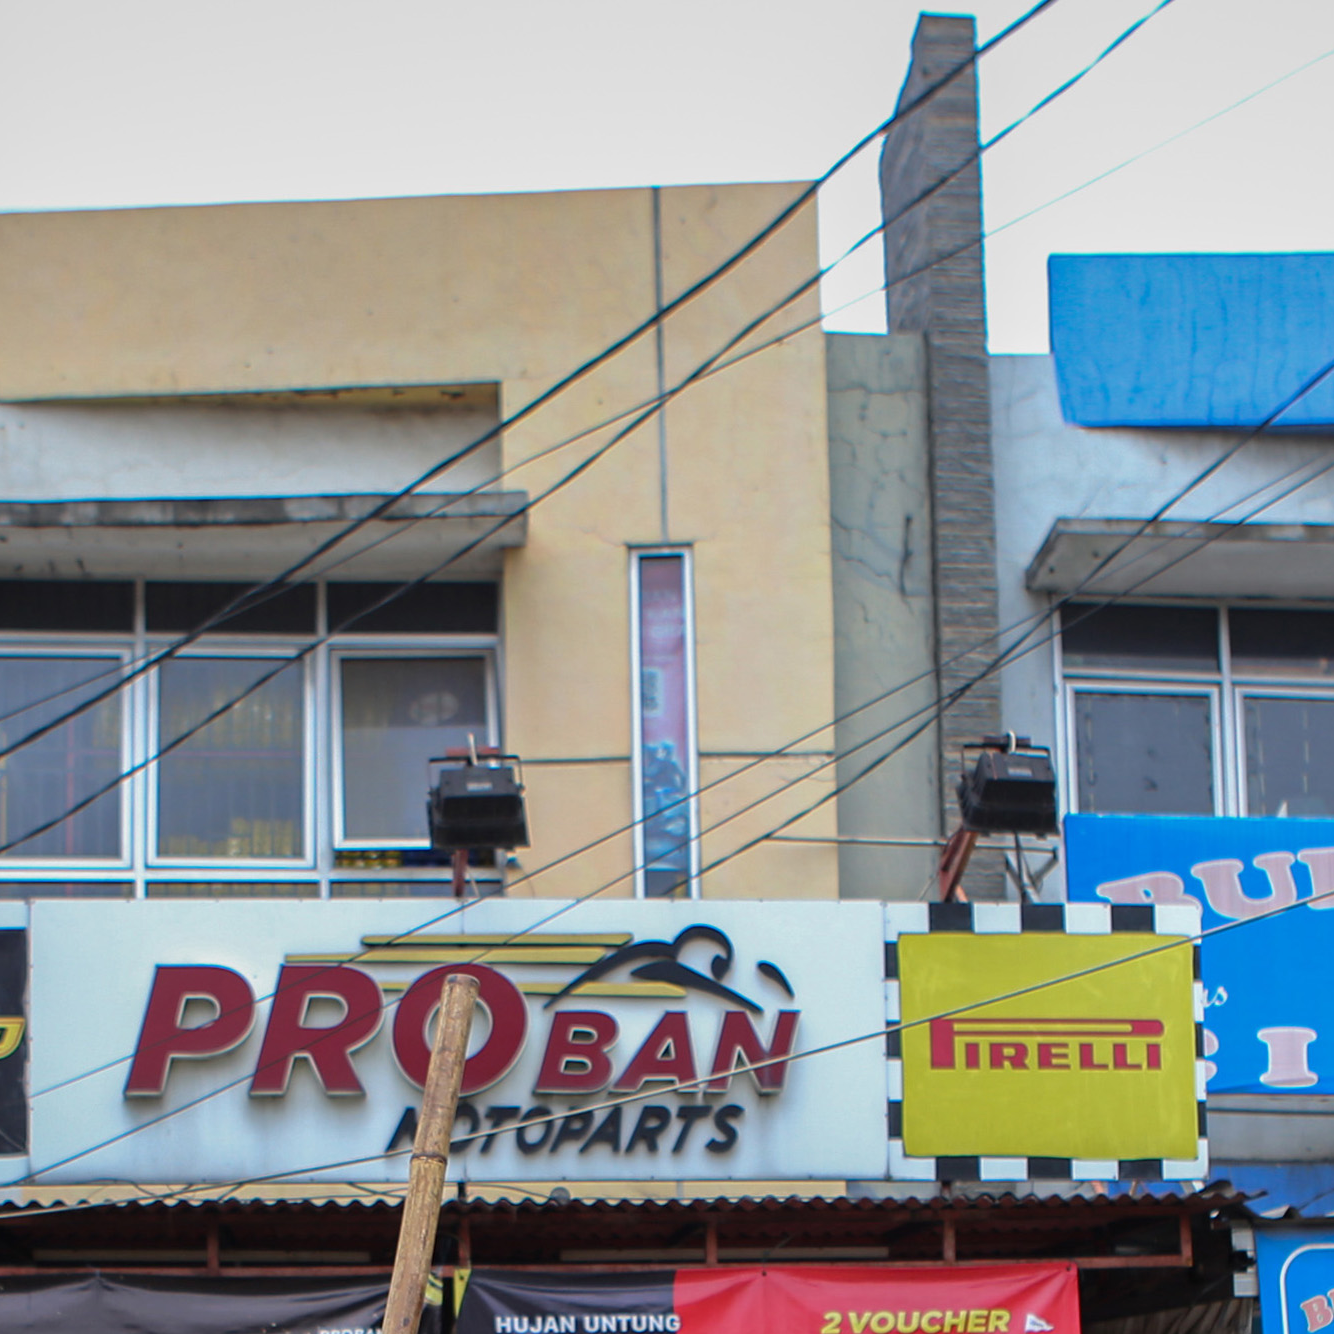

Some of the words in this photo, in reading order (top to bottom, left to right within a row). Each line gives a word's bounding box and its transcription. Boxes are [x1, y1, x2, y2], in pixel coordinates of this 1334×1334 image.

[123, 962, 800, 1100] PROBAN
[929, 1018, 1164, 1070] PIRELLI
[494, 1315, 576, 1334] HUJAN
[583, 1313, 681, 1333] UNTUNG
